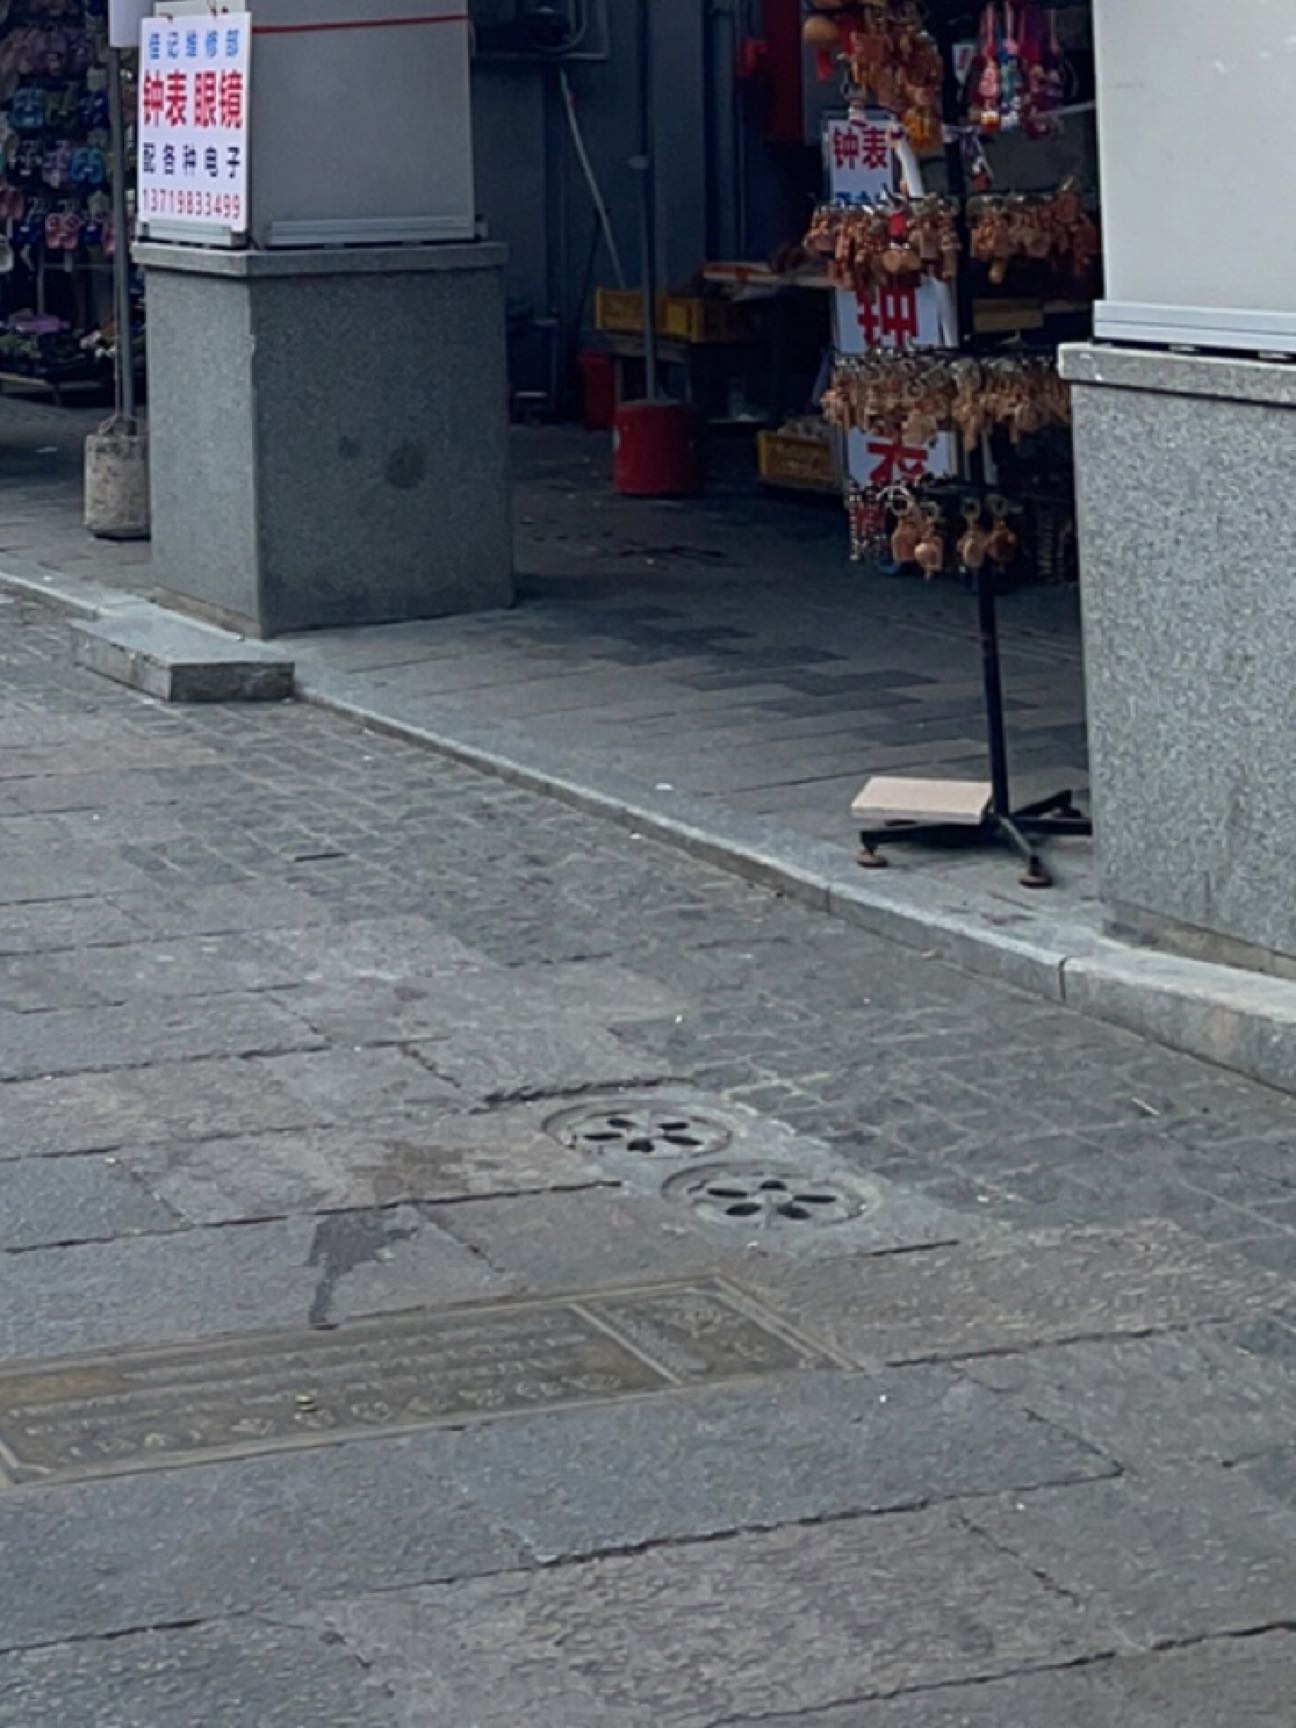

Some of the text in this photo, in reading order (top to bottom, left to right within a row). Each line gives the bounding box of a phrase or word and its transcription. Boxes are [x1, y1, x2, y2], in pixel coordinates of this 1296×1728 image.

[142, 69, 244, 129] 钟表眼镜
[833, 125, 889, 170] 钟表
[142, 189, 241, 221] 13719833499
